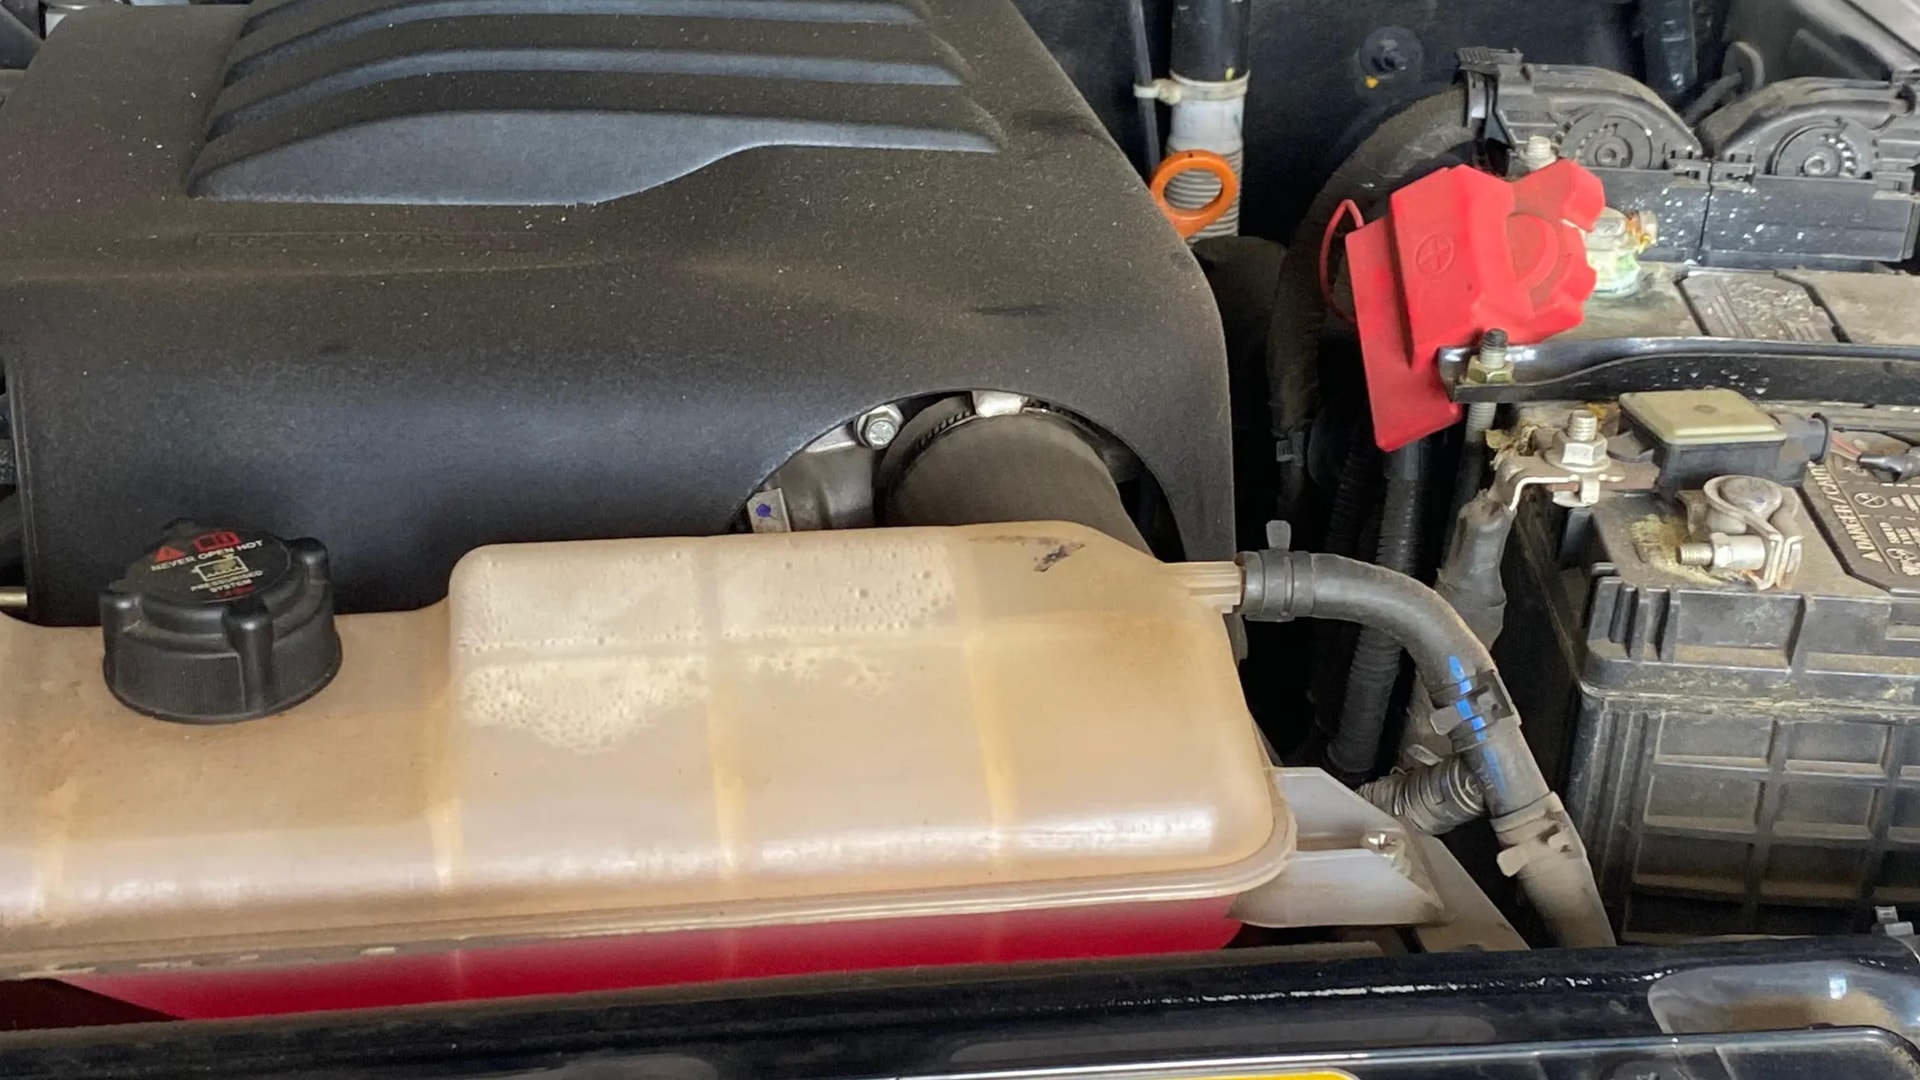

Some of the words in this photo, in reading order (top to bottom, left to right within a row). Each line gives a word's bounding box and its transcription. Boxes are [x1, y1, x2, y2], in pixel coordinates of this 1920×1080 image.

[151, 556, 197, 571] NEVER
[198, 547, 235, 560] OPEN
[236, 540, 264, 551] HOT
[209, 579, 253, 593] SYSTEM
